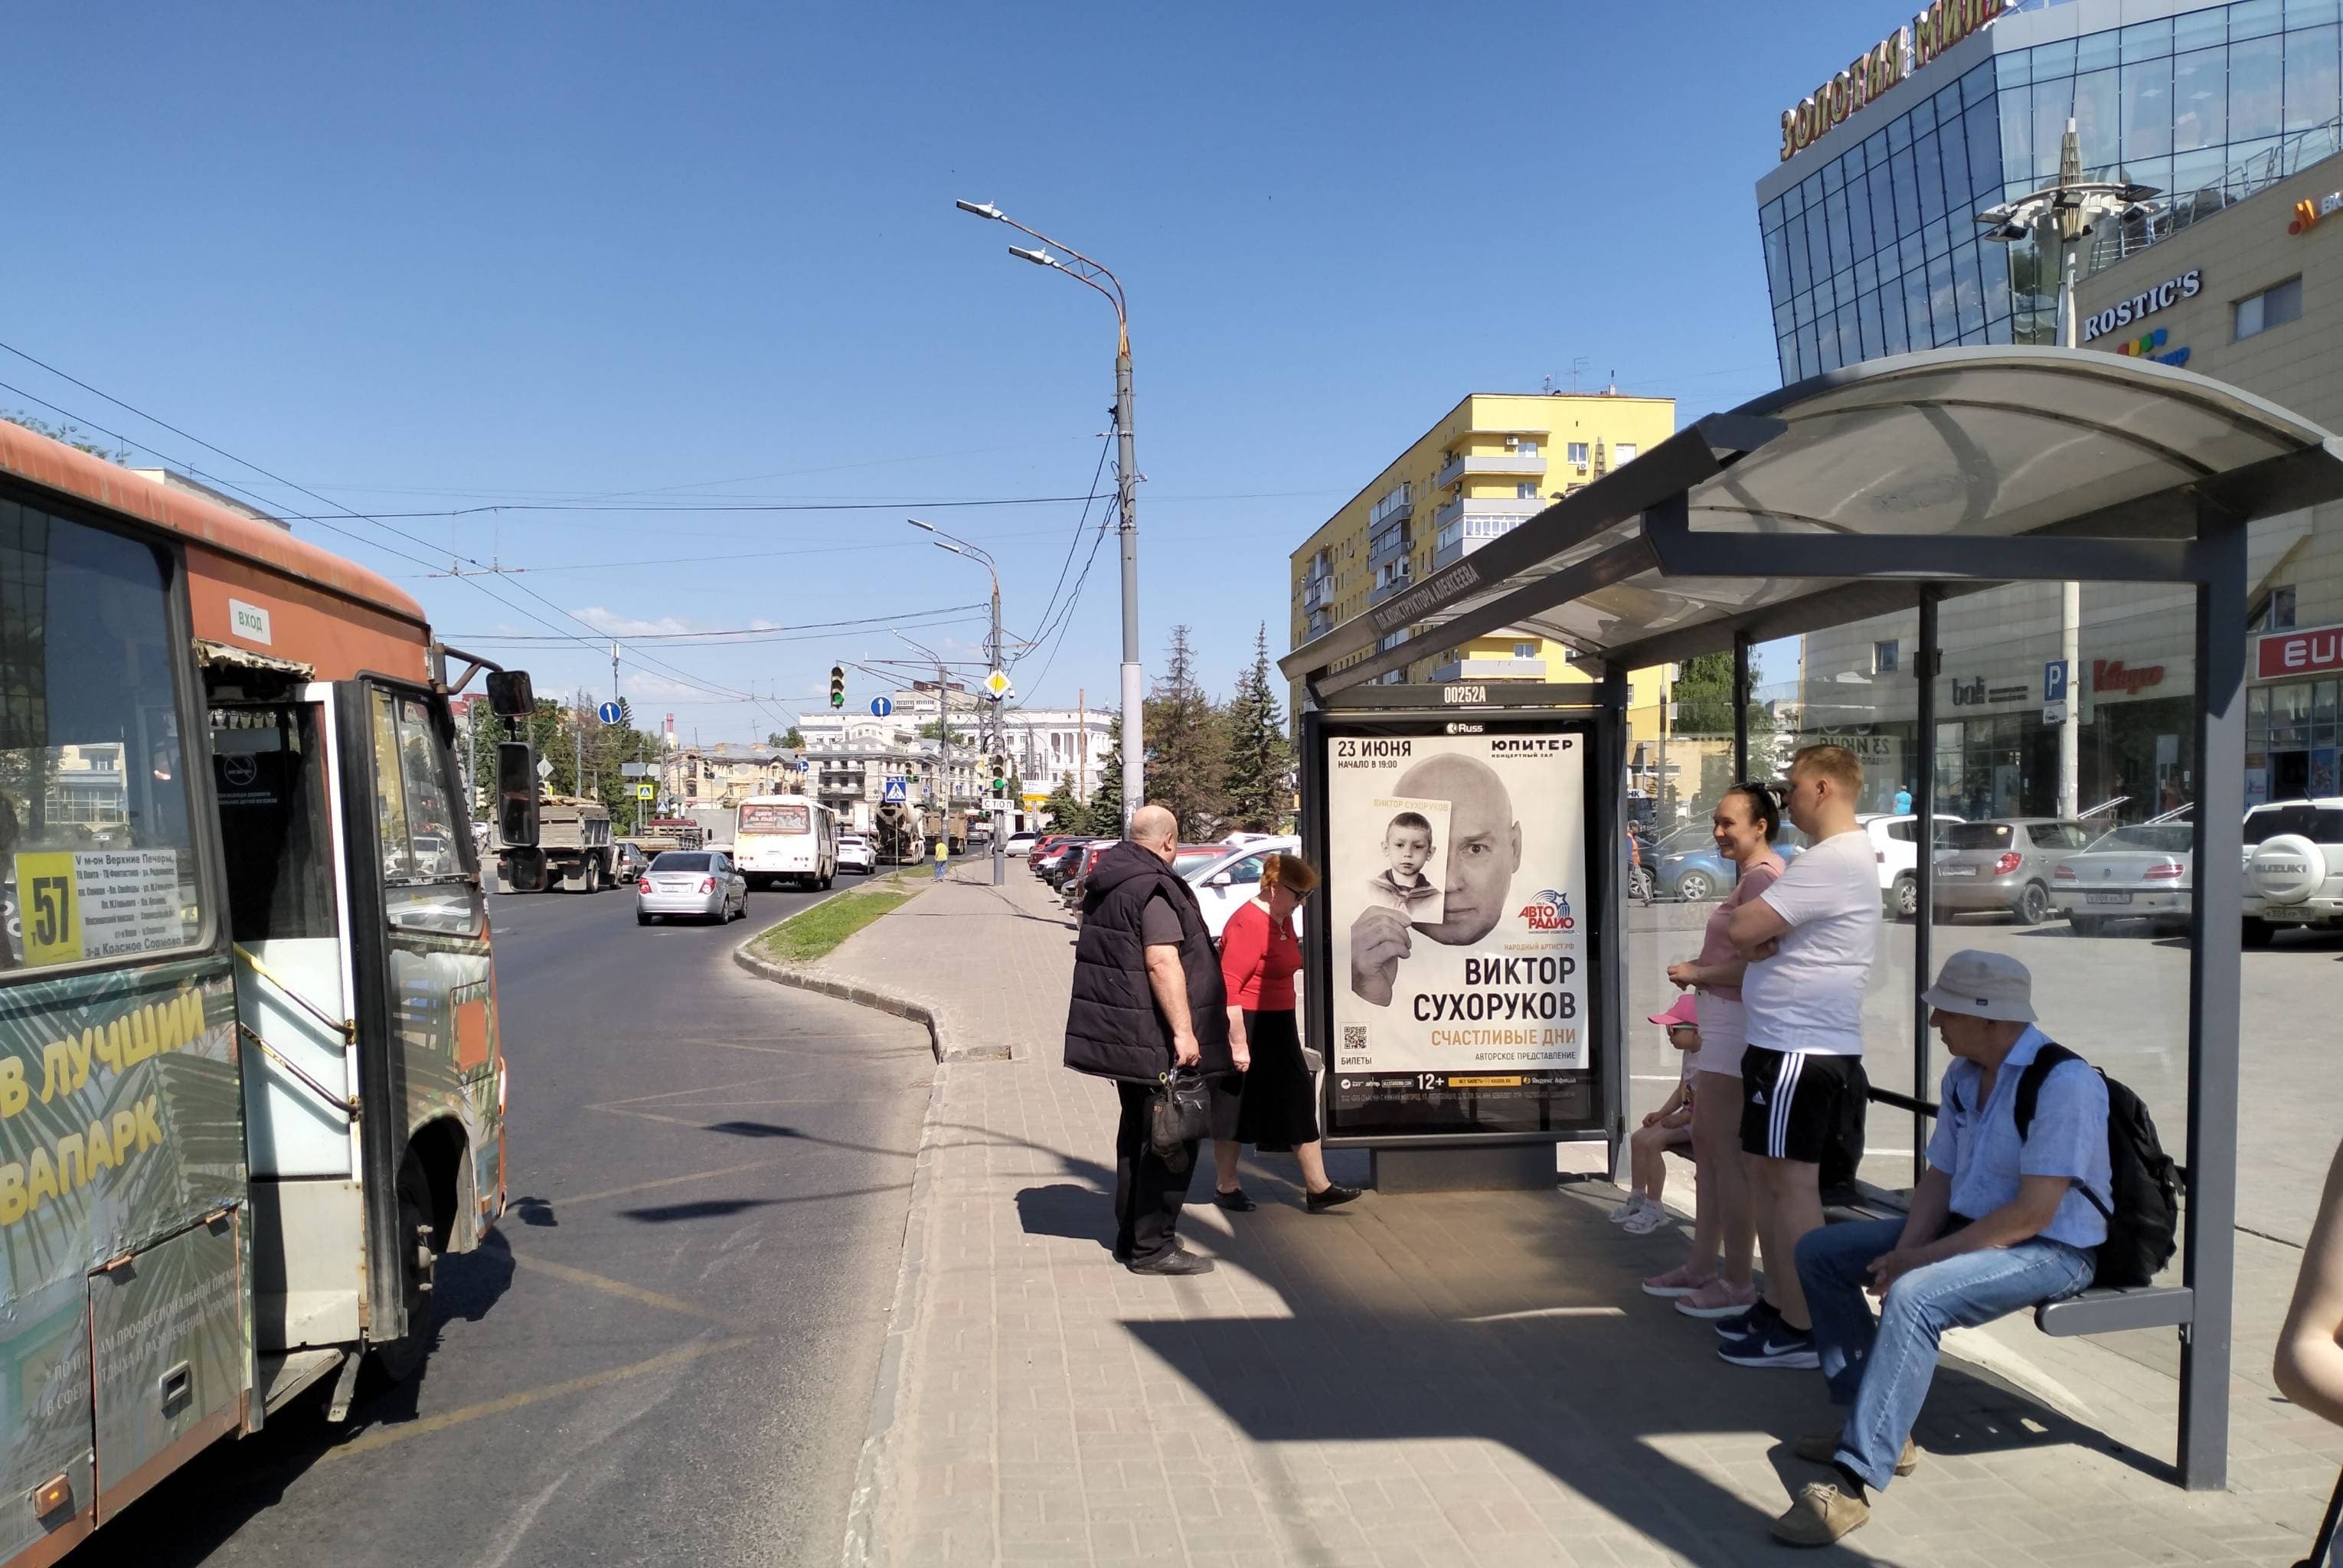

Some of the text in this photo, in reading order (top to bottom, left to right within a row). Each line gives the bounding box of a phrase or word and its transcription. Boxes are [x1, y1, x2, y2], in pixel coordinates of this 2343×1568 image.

[1780, 0, 2010, 162] ЗОЛОТАЯ МИЛ
[2084, 270, 2201, 341] ROSTIC'S
[1432, 563, 1480, 601] АЛЕКСЕЕВА
[238, 611, 263, 633] ВХОД
[2284, 633, 2343, 667] EU
[1458, 724, 1483, 733] Russ
[1338, 740, 1411, 757] 23 ИЮНЯ
[1492, 740, 1573, 751] ЮПИТЕР
[1338, 760, 1397, 769] НАЧАЛО В 19:00
[985, 800, 1012, 808] СТОП
[1374, 799, 1448, 812] ВИКТОР СУХОРУКОВ
[106, 854, 140, 867] Верхние
[2255, 864, 2306, 873] SUZUKI
[1518, 906, 1554, 918] АВТО
[1528, 917, 1575, 929] РАДИО
[103, 942, 142, 955] Красное
[144, 938, 181, 949] Сормово
[1466, 956, 1576, 985] ВИКТОР
[1413, 992, 1577, 1021] СУХОРУКОВ
[1431, 1028, 1576, 1047] СЧАСТЛИВЫЕ ДНИ
[1341, 1057, 1372, 1065] БИЛЕТЫ
[1475, 1051, 1576, 1061] АВТОРСКОЕ ПРЕДСТАВЛЕНИЕ
[1417, 1073, 1445, 1090] 12+
